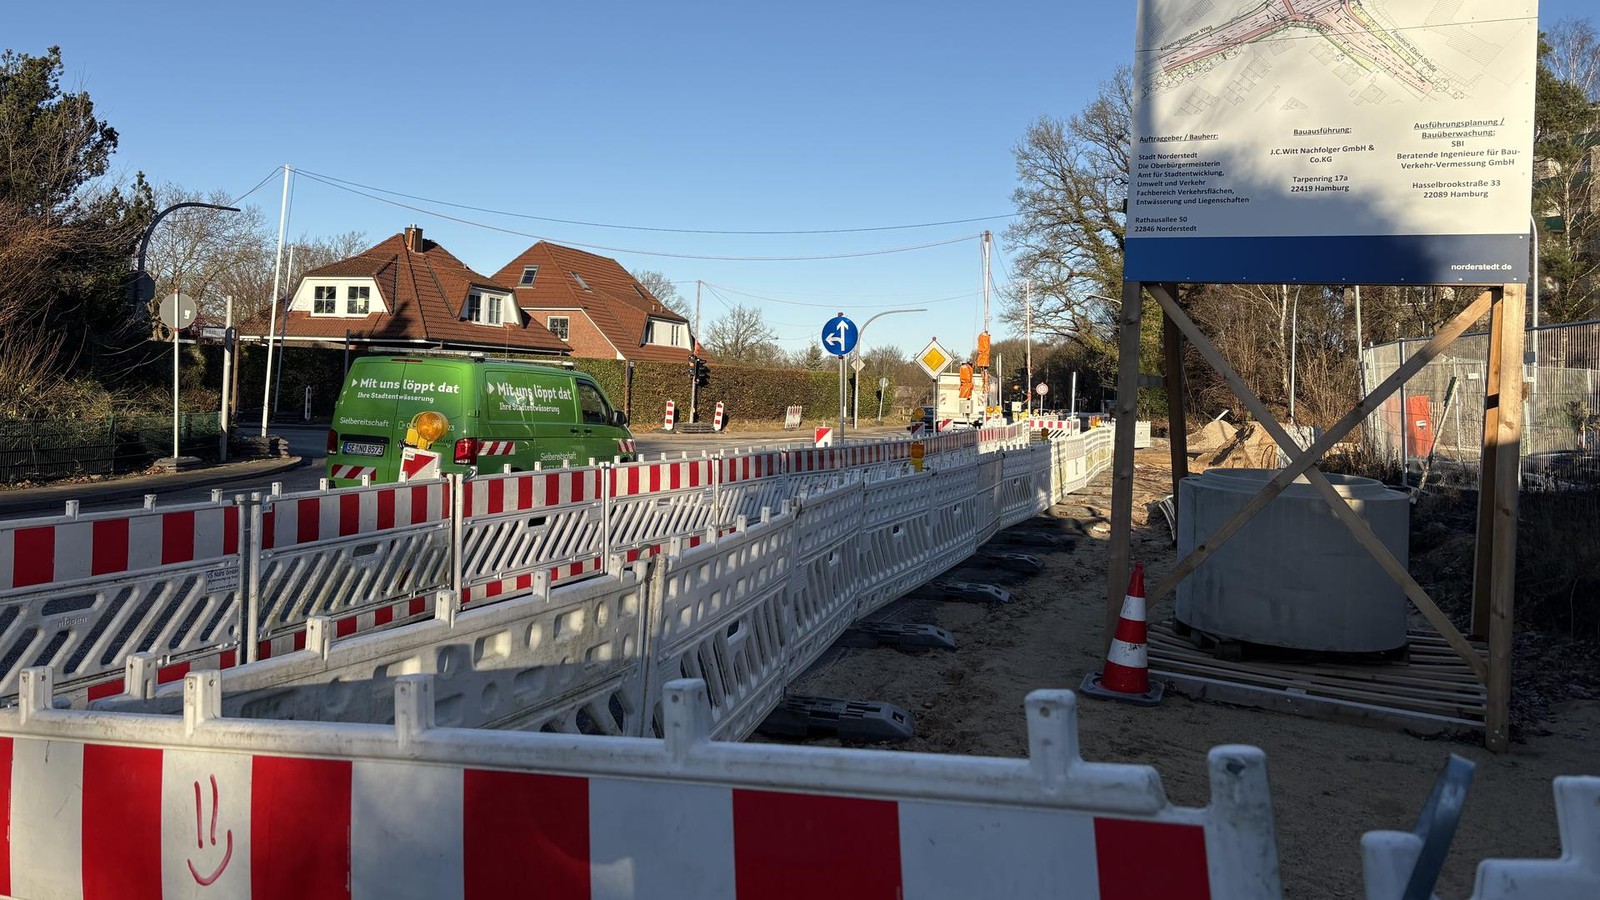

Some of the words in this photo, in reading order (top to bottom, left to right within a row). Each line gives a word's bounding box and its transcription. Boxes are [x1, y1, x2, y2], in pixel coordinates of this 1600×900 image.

[1414, 119, 1498, 130] Ausführungsplanung
[1500, 117, 1505, 126] /
[1293, 127, 1352, 136] Bauausführung:
[1421, 129, 1496, 139] Bauüberwachung:
[1189, 133, 1219, 141] Bauherr:
[1300, 146, 1340, 154] Nachfolger
[1440, 150, 1485, 159] Ingenieure
[1157, 152, 1198, 160] Norderstedt
[1150, 161, 1221, 169] Oberbürgermeisterin
[1400, 160, 1486, 169] Verkehr-Vermessung
[1164, 170, 1225, 178] Stadtentwicklung,
[1293, 175, 1333, 183] Tarpenring
[1412, 180, 1488, 189] Hasselbrookstraße
[1178, 188, 1234, 196] Verkehrsflächen,
[1450, 190, 1489, 198] Hamburg
[1198, 197, 1250, 205] Liegenschaften
[360, 378, 377, 388] Mit
[379, 380, 400, 389] uns
[403, 379, 435, 394] löppt
[438, 382, 460, 394] dat
[496, 382, 514, 396] Mit
[516, 386, 533, 398] uns
[534, 384, 557, 402] löppt
[558, 387, 572, 400] dat
[370, 392, 434, 404] Stadtentwässerung
[499, 402, 511, 411] Ihre
[513, 403, 560, 415] Stadtentwässerung
[339, 417, 389, 428] Sielbereitschaft
[540, 451, 577, 461] Sielbereitschaft
